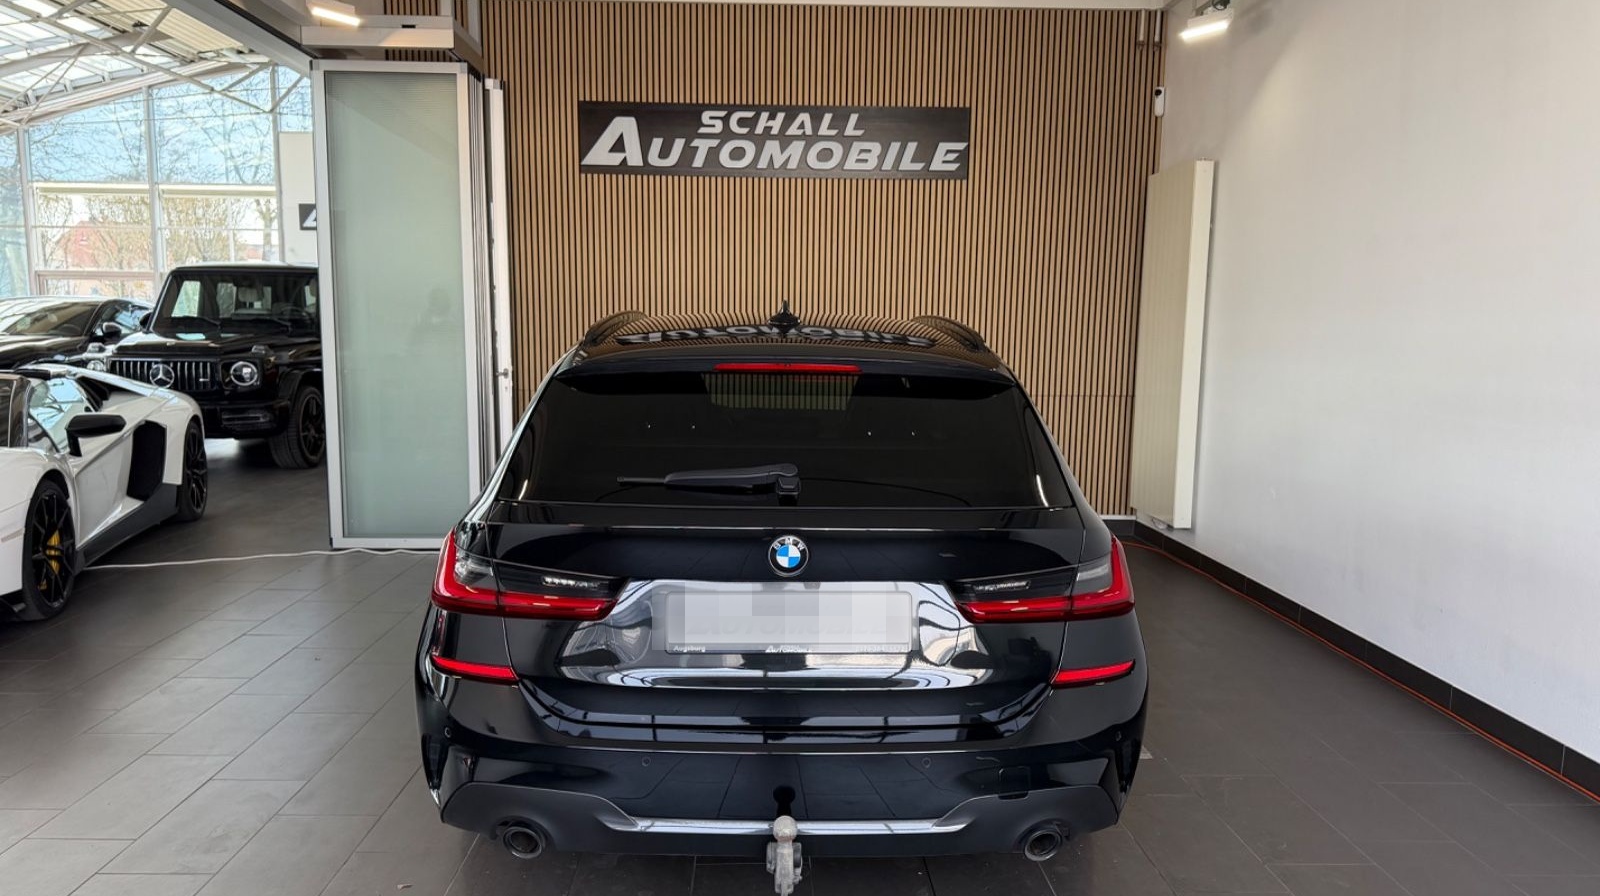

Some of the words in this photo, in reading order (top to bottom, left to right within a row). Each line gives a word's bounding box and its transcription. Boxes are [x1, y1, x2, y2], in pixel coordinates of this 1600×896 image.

[698, 110, 866, 136] SCHALL
[581, 116, 969, 172] AUTOMOBILE
[772, 536, 805, 551] BMW
[673, 645, 706, 653] Augsburg
